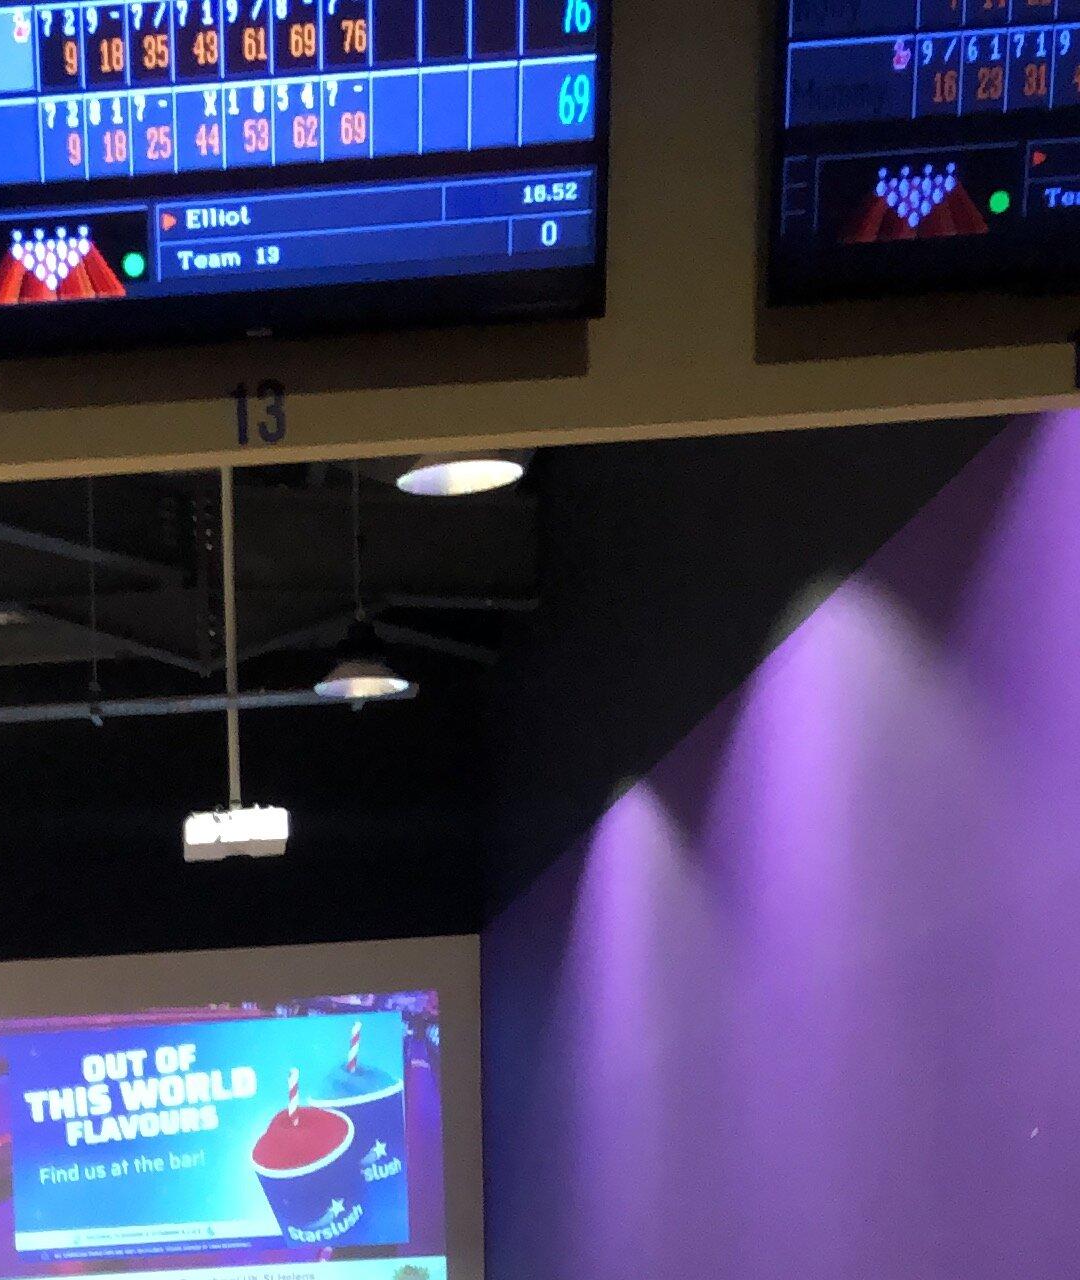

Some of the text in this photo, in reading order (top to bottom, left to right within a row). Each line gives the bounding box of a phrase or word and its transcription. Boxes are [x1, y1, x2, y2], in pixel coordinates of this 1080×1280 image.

[64, 41, 78, 75] 9
[100, 37, 124, 73] 18
[143, 34, 169, 69] 35
[193, 30, 218, 65] 43
[243, 27, 267, 61] 61
[290, 23, 316, 57] 69
[341, 19, 367, 54] 76
[1024, 63, 1047, 96] 31
[67, 132, 81, 166] 9
[103, 129, 126, 163] 18
[146, 126, 172, 160] 25
[195, 123, 220, 156] 44
[243, 118, 269, 153] 53
[292, 115, 318, 149] 62
[340, 111, 366, 145] 69
[558, 74, 590, 125] 69
[186, 205, 251, 230] Elliot
[541, 220, 557, 247] 0
[177, 245, 280, 271] Team 13
[229, 380, 286, 446] 13
[82, 1043, 196, 1083] OUT OF
[23, 1066, 258, 1123] THIS WORLD
[65, 1105, 219, 1147] FLAVOURS
[39, 1150, 205, 1185] Find us at the bar!
[363, 1157, 401, 1182] slush
